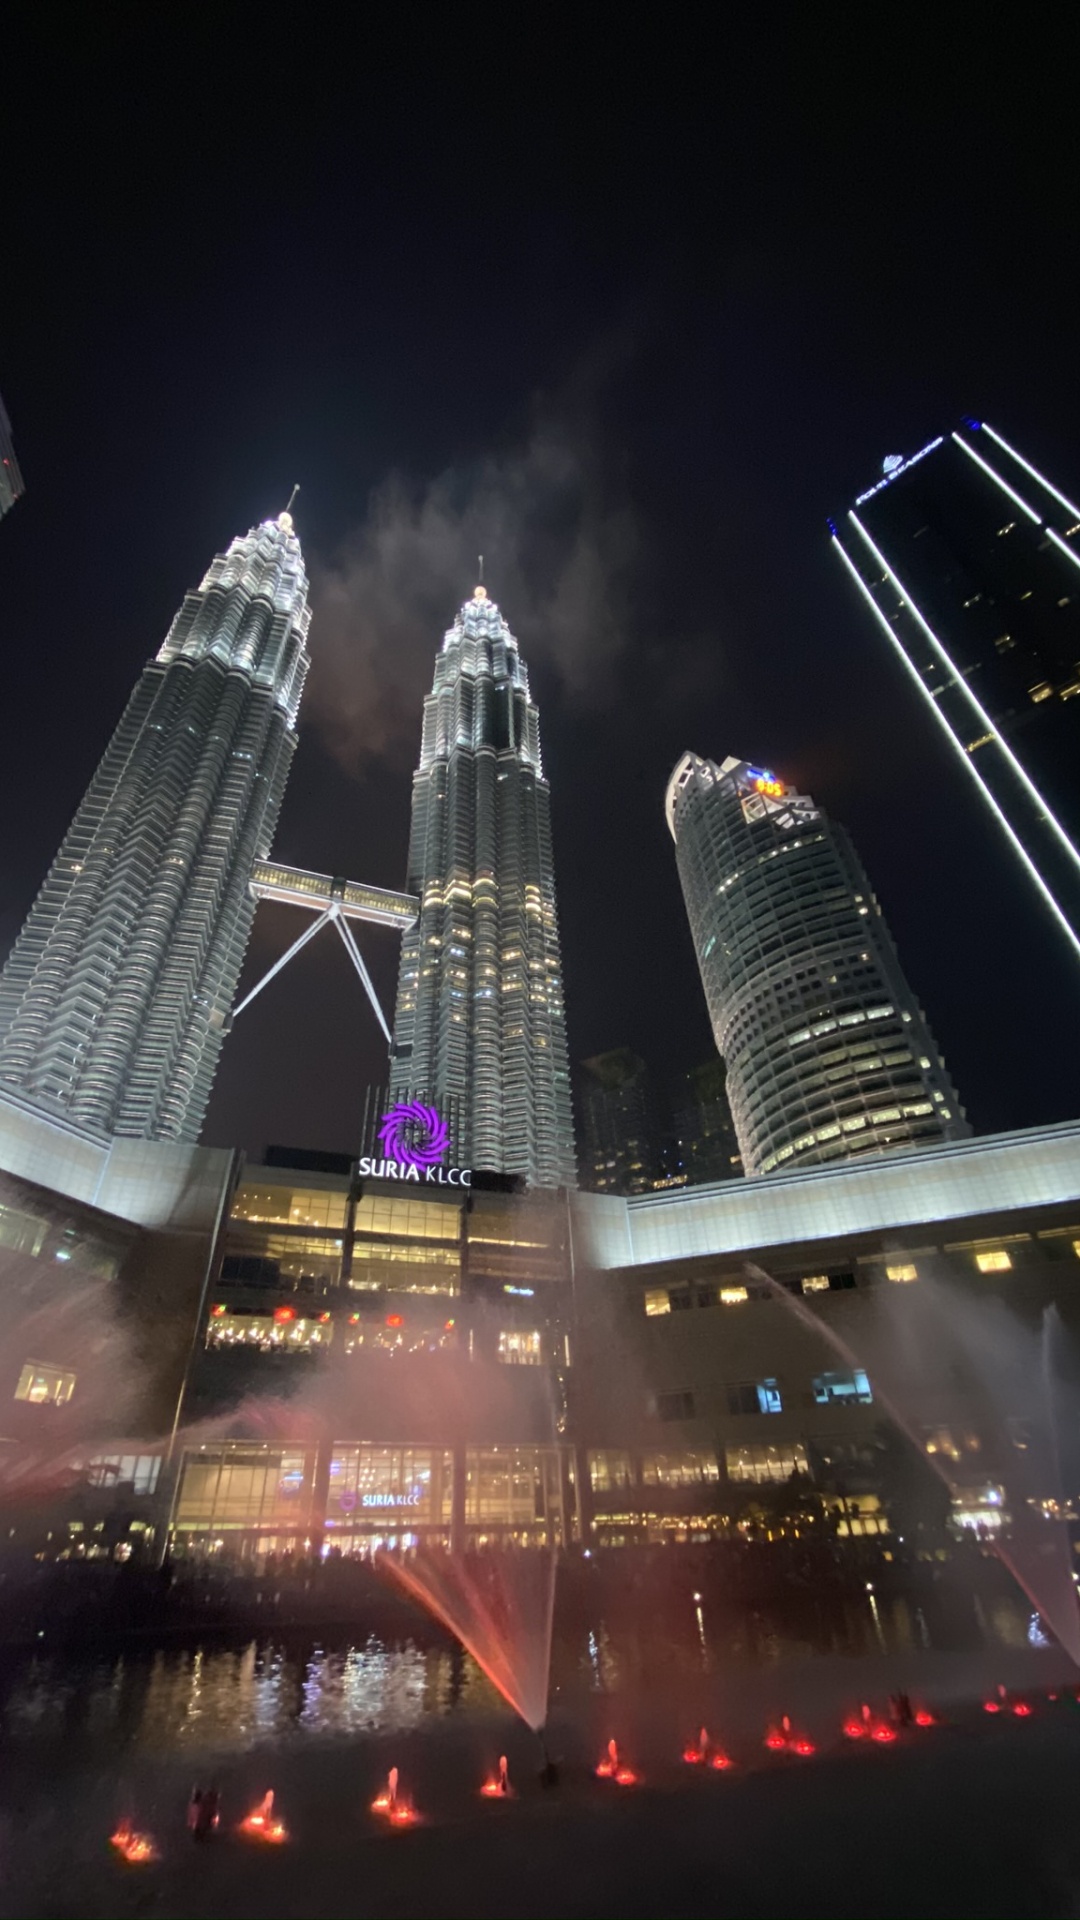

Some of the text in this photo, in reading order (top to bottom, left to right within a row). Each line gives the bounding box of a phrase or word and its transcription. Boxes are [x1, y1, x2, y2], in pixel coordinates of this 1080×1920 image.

[359, 1157, 472, 1186] SURIA KLCC
[362, 1494, 420, 1507] SURIA KLCC
